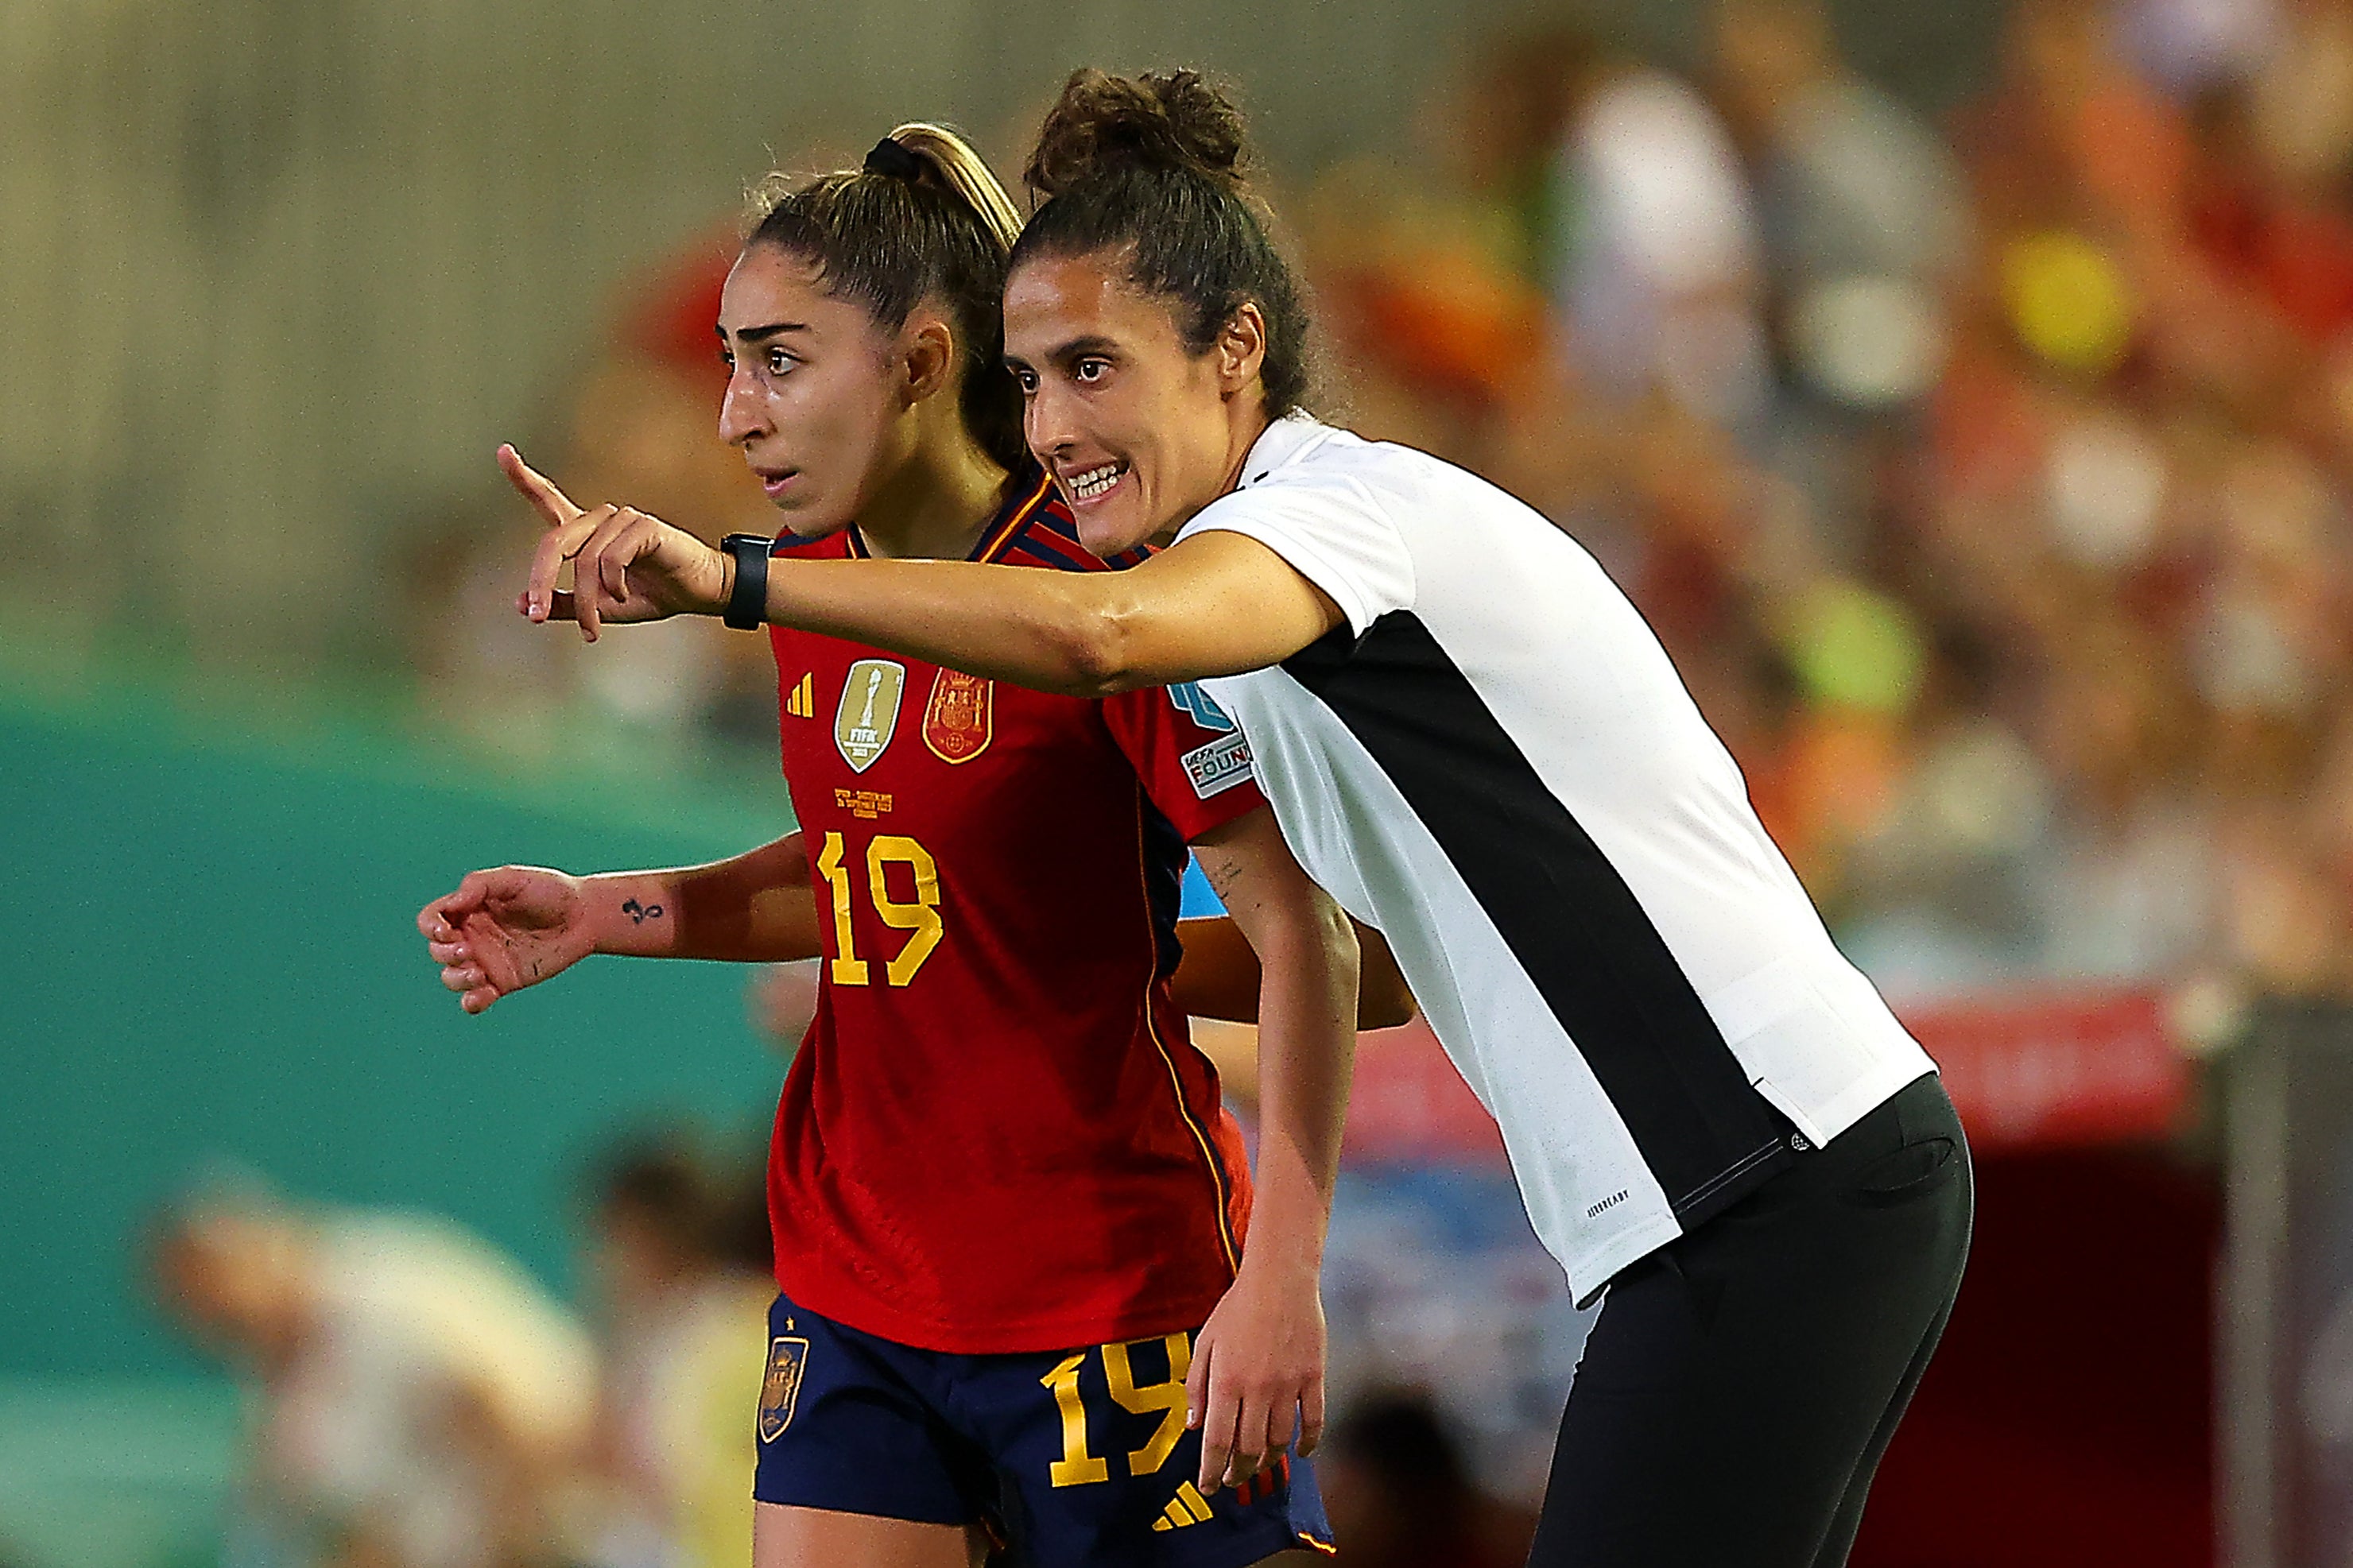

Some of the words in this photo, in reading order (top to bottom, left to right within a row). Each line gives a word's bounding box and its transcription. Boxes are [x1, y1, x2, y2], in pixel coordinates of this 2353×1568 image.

[850, 728, 878, 743] FIFA
[1185, 748, 1215, 767] UEFA
[817, 831, 944, 986] 19
[1040, 1332, 1191, 1488] 19
